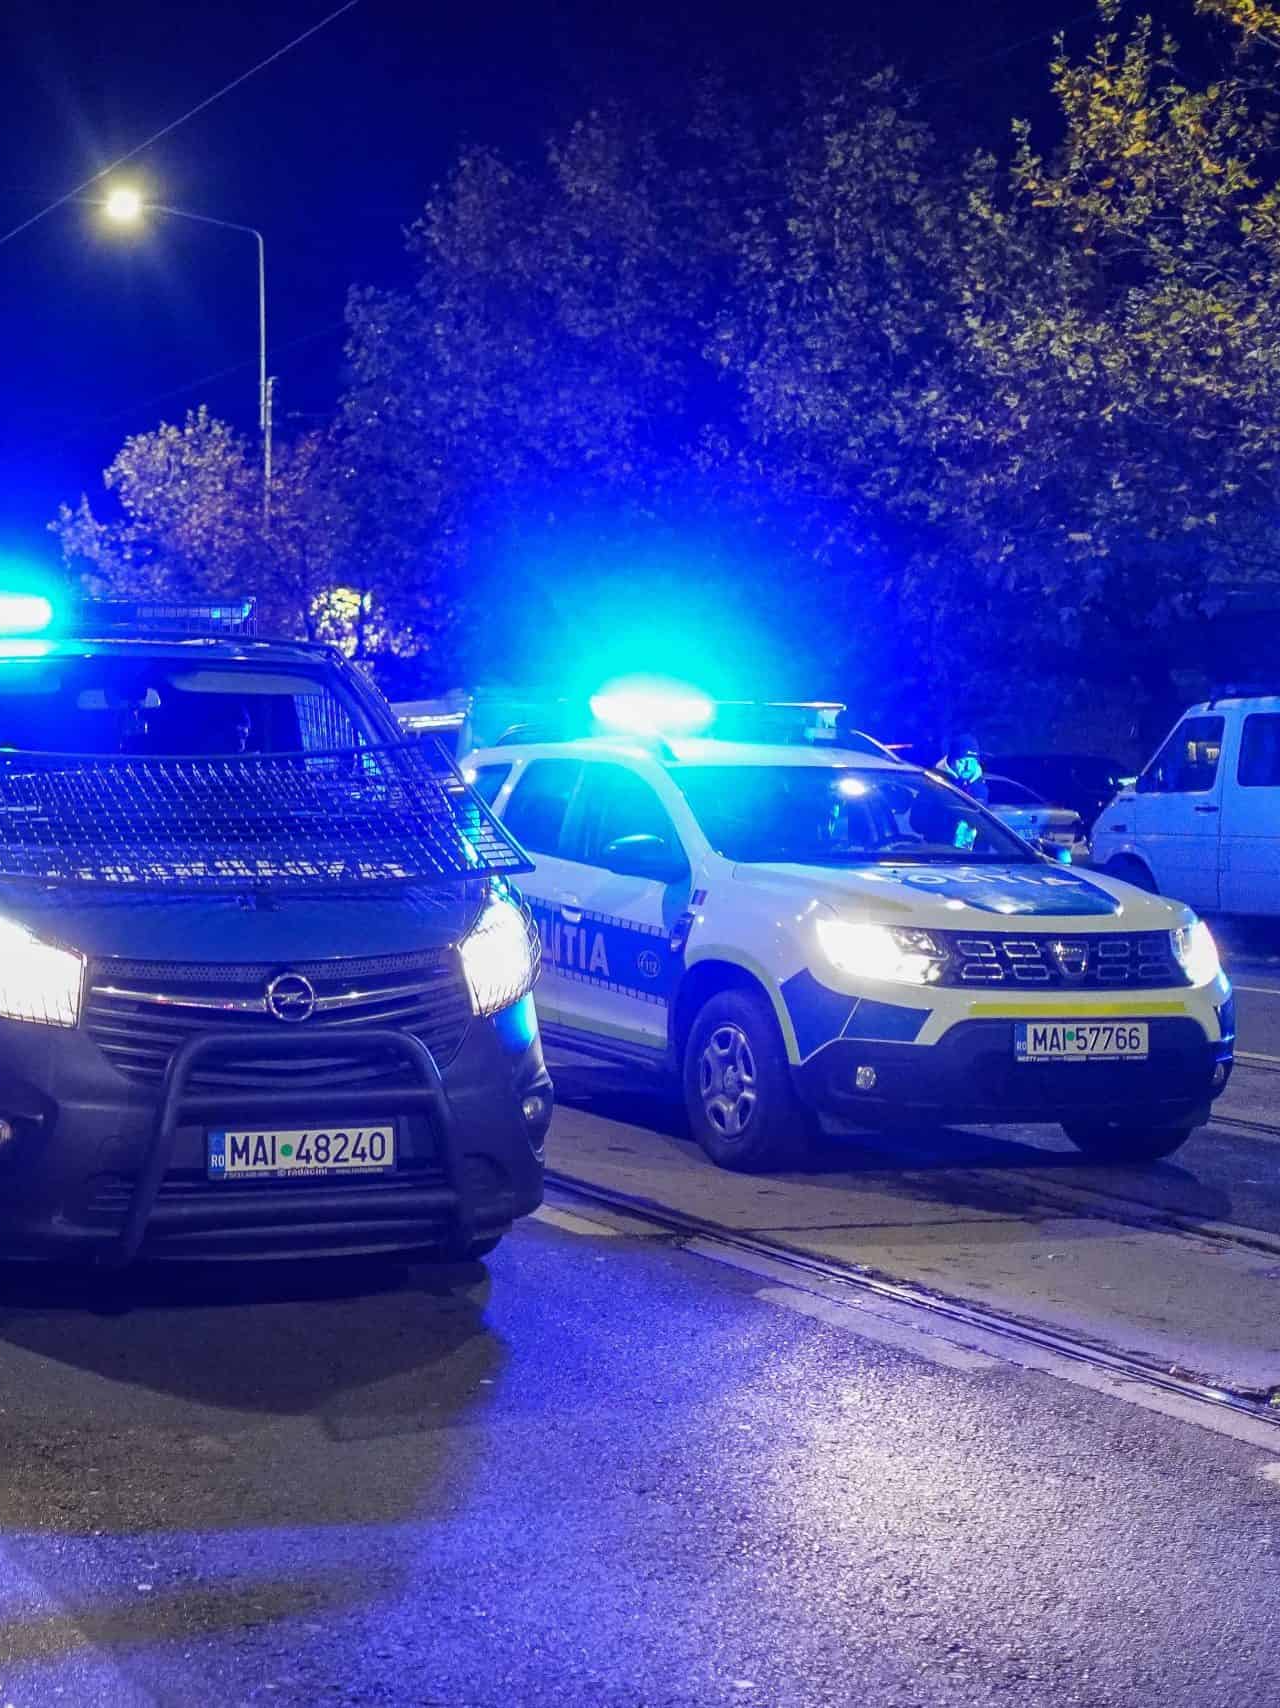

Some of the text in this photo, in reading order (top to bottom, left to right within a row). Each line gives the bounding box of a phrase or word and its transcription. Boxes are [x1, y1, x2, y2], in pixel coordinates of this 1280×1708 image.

[1032, 1027, 1141, 1052] MAI 57766
[211, 1154, 225, 1167] RO
[230, 1131, 386, 1167] MAI 48240
